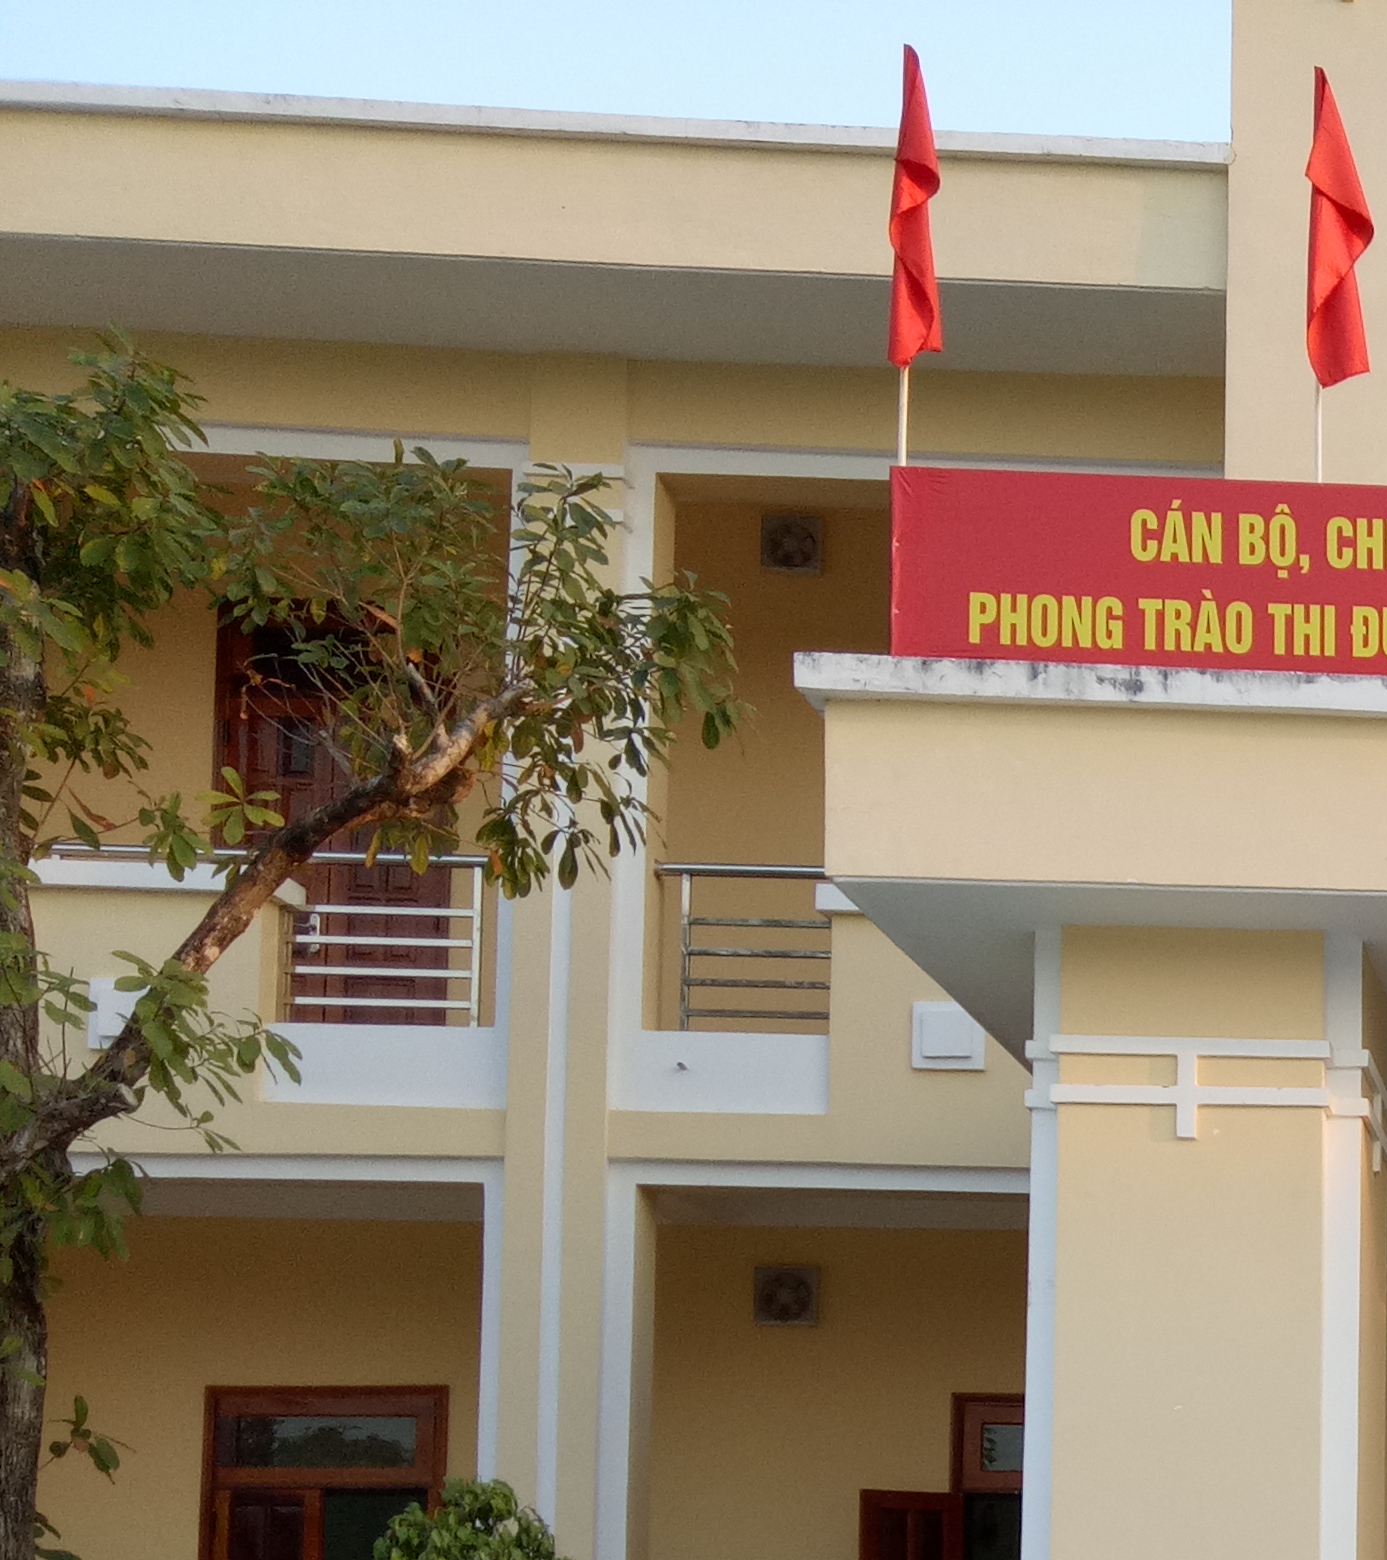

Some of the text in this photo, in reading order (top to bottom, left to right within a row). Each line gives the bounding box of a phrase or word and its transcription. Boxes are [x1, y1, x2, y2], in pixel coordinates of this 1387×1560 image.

[1130, 499, 1223, 564] CÁN
[969, 592, 1124, 650] PHONG
[1138, 589, 1253, 655] TRÀO
[1267, 603, 1336, 657] THI
